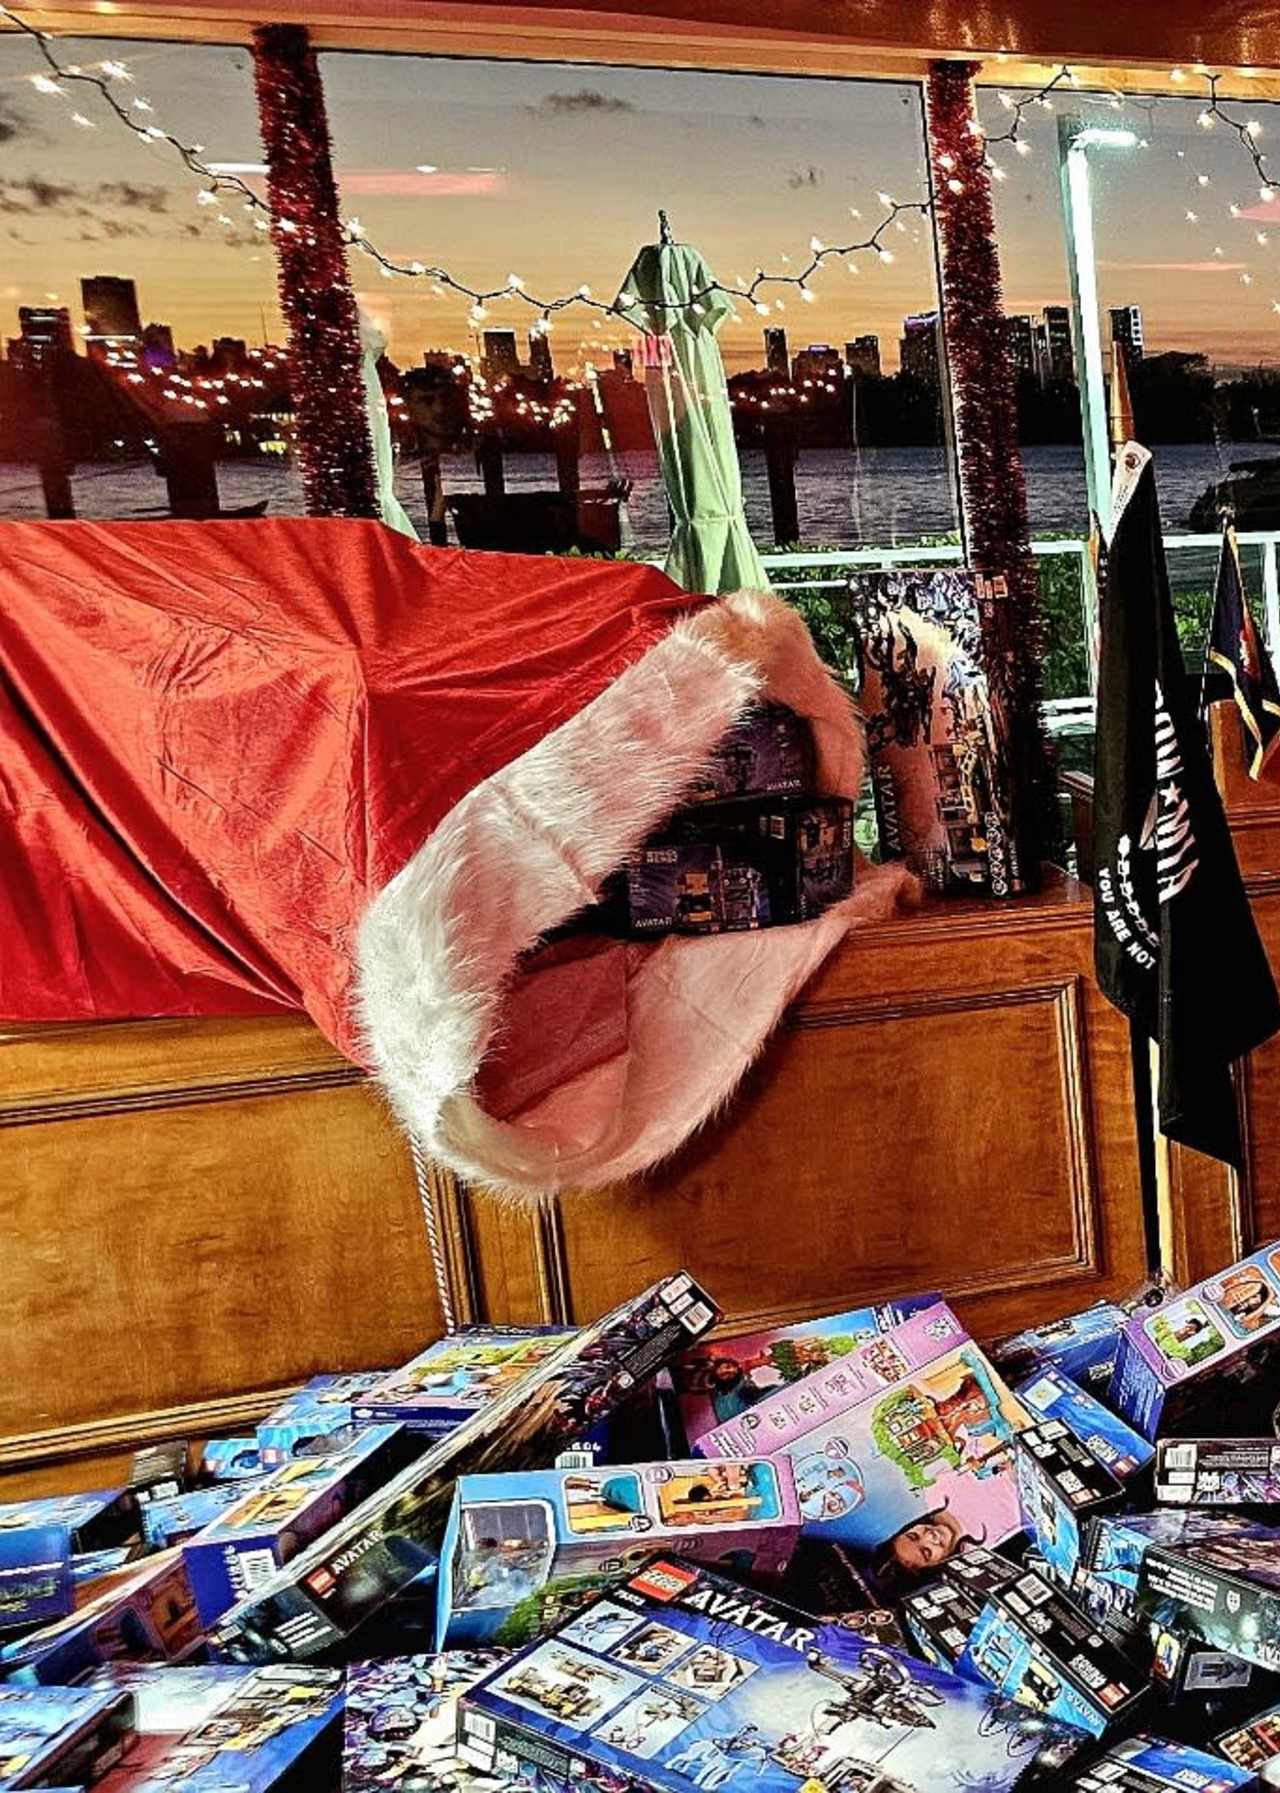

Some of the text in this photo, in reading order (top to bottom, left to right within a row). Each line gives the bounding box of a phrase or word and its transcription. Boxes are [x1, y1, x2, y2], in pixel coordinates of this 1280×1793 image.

[767, 778, 801, 791] AVATAR
[877, 765, 903, 851] AVATAR
[635, 917, 673, 928] AVATAR
[1098, 866, 1157, 971] YOU ARE NOT
[331, 1529, 385, 1576] AVATAR
[681, 1589, 816, 1652] AVATAR
